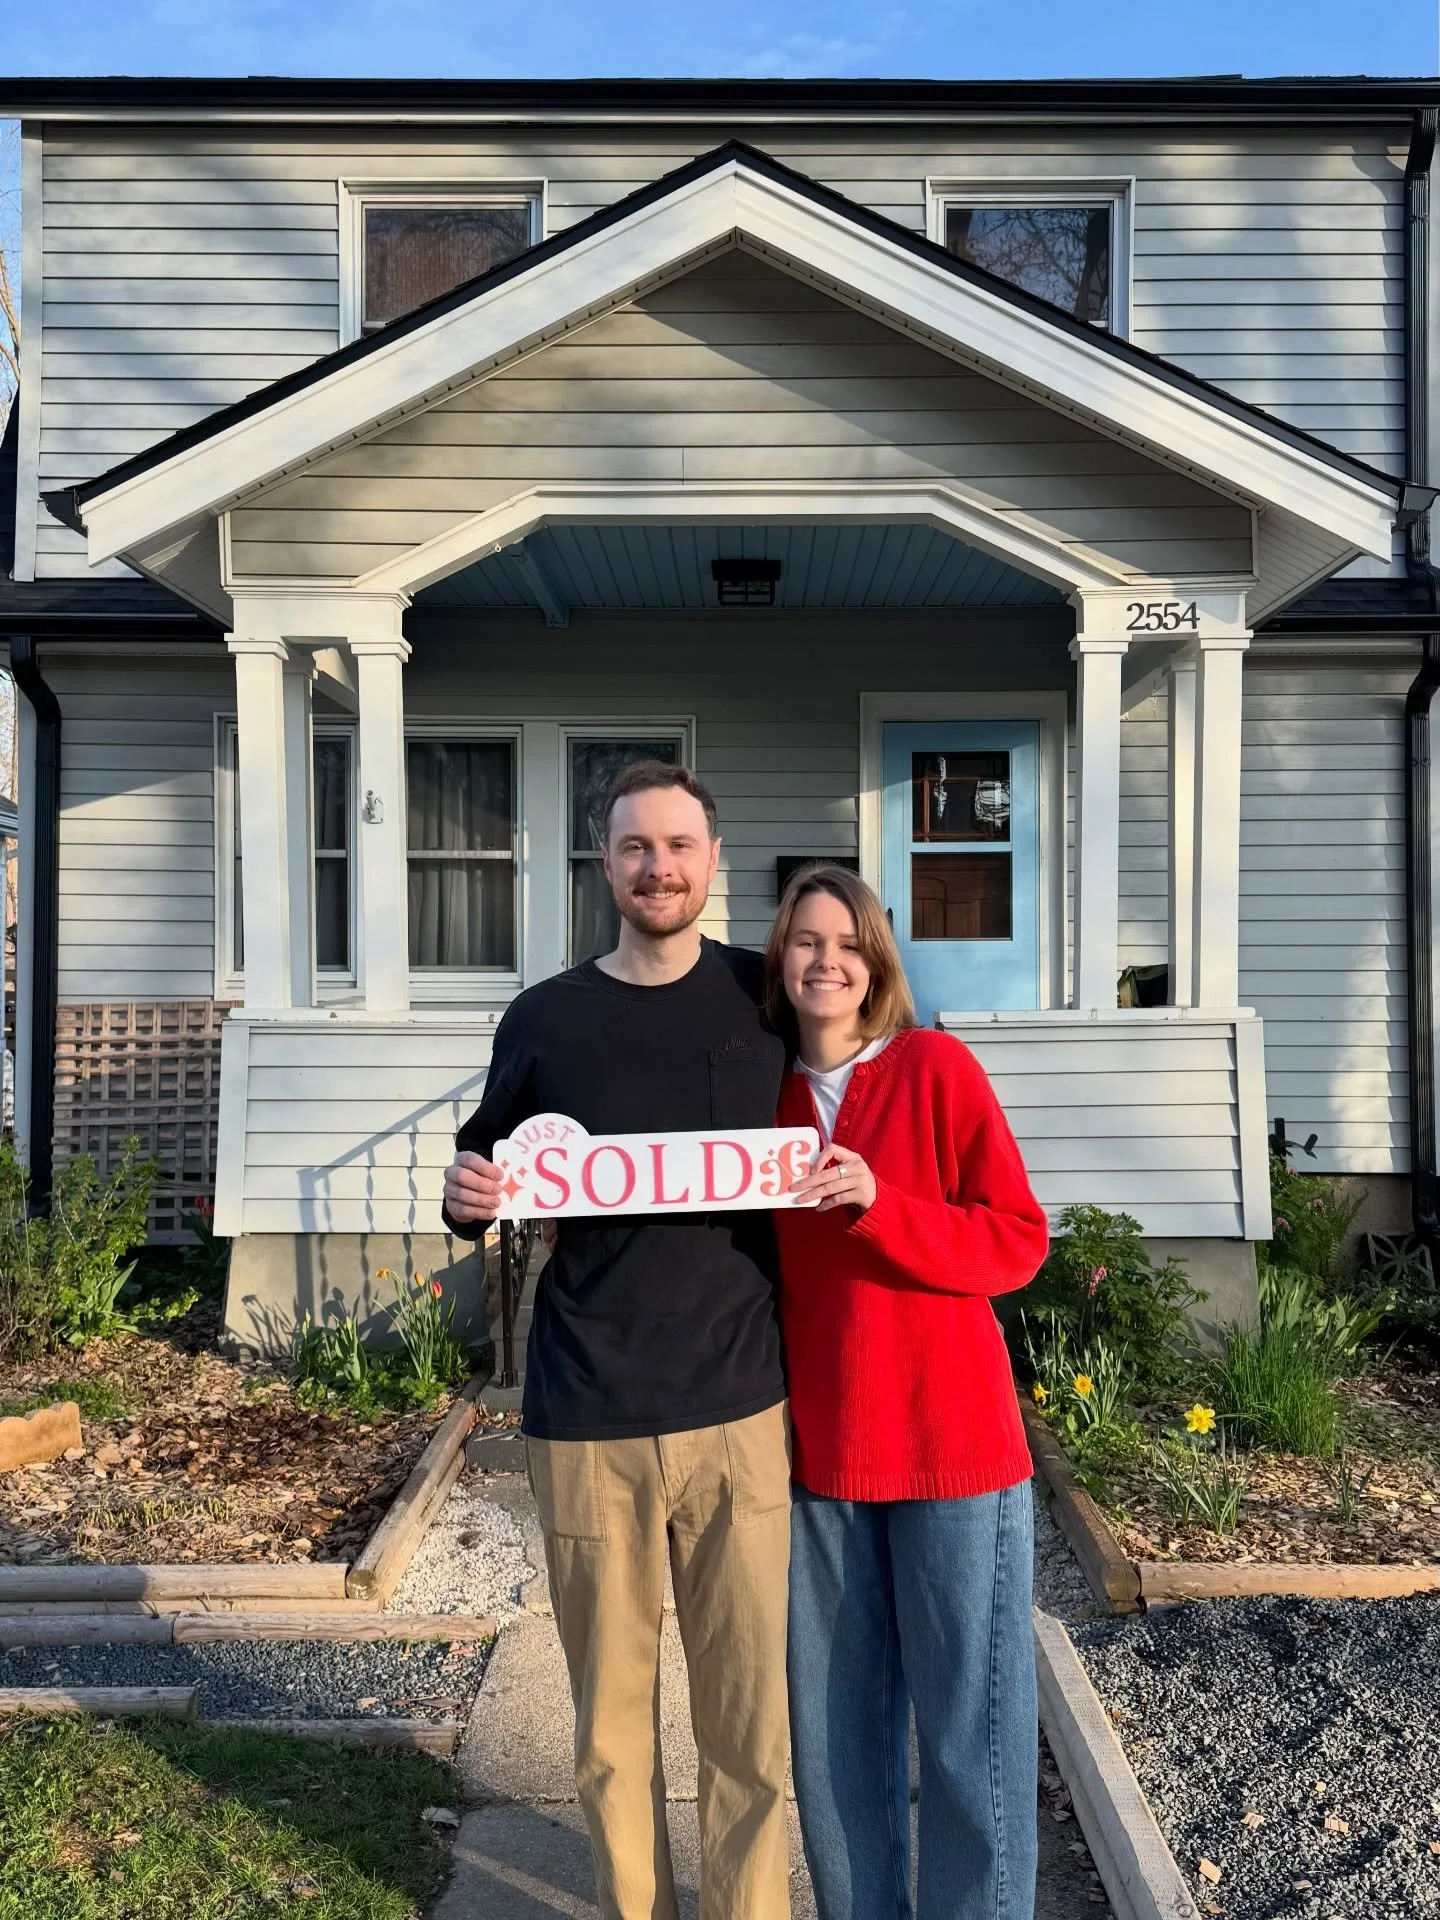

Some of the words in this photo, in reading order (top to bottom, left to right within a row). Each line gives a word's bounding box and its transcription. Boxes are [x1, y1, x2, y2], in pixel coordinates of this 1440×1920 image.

[1126, 602, 1200, 631] 2554
[515, 1121, 576, 1154] JUST
[533, 1140, 754, 1210] SOLD
